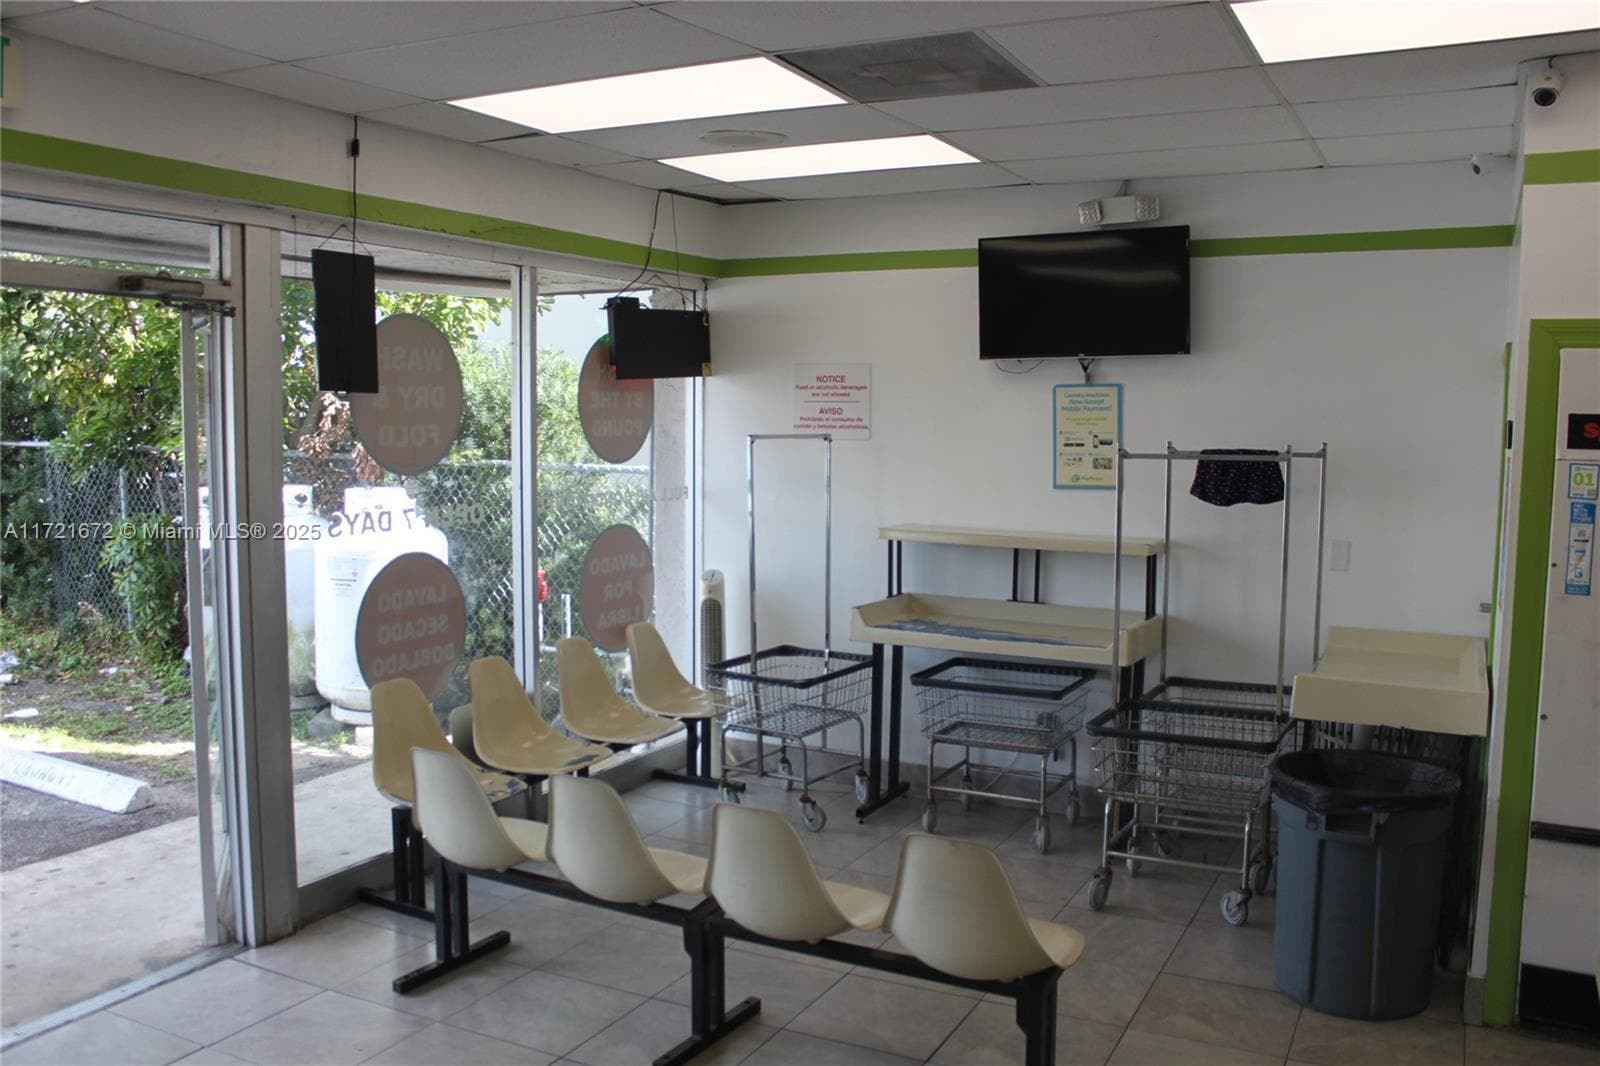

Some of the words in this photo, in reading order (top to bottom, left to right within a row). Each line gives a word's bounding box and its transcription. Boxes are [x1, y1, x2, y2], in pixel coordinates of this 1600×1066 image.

[816, 375, 847, 383] NOTICE
[841, 384, 868, 392] beverages
[819, 407, 843, 415] AVISO
[1573, 472, 1595, 487] 01
